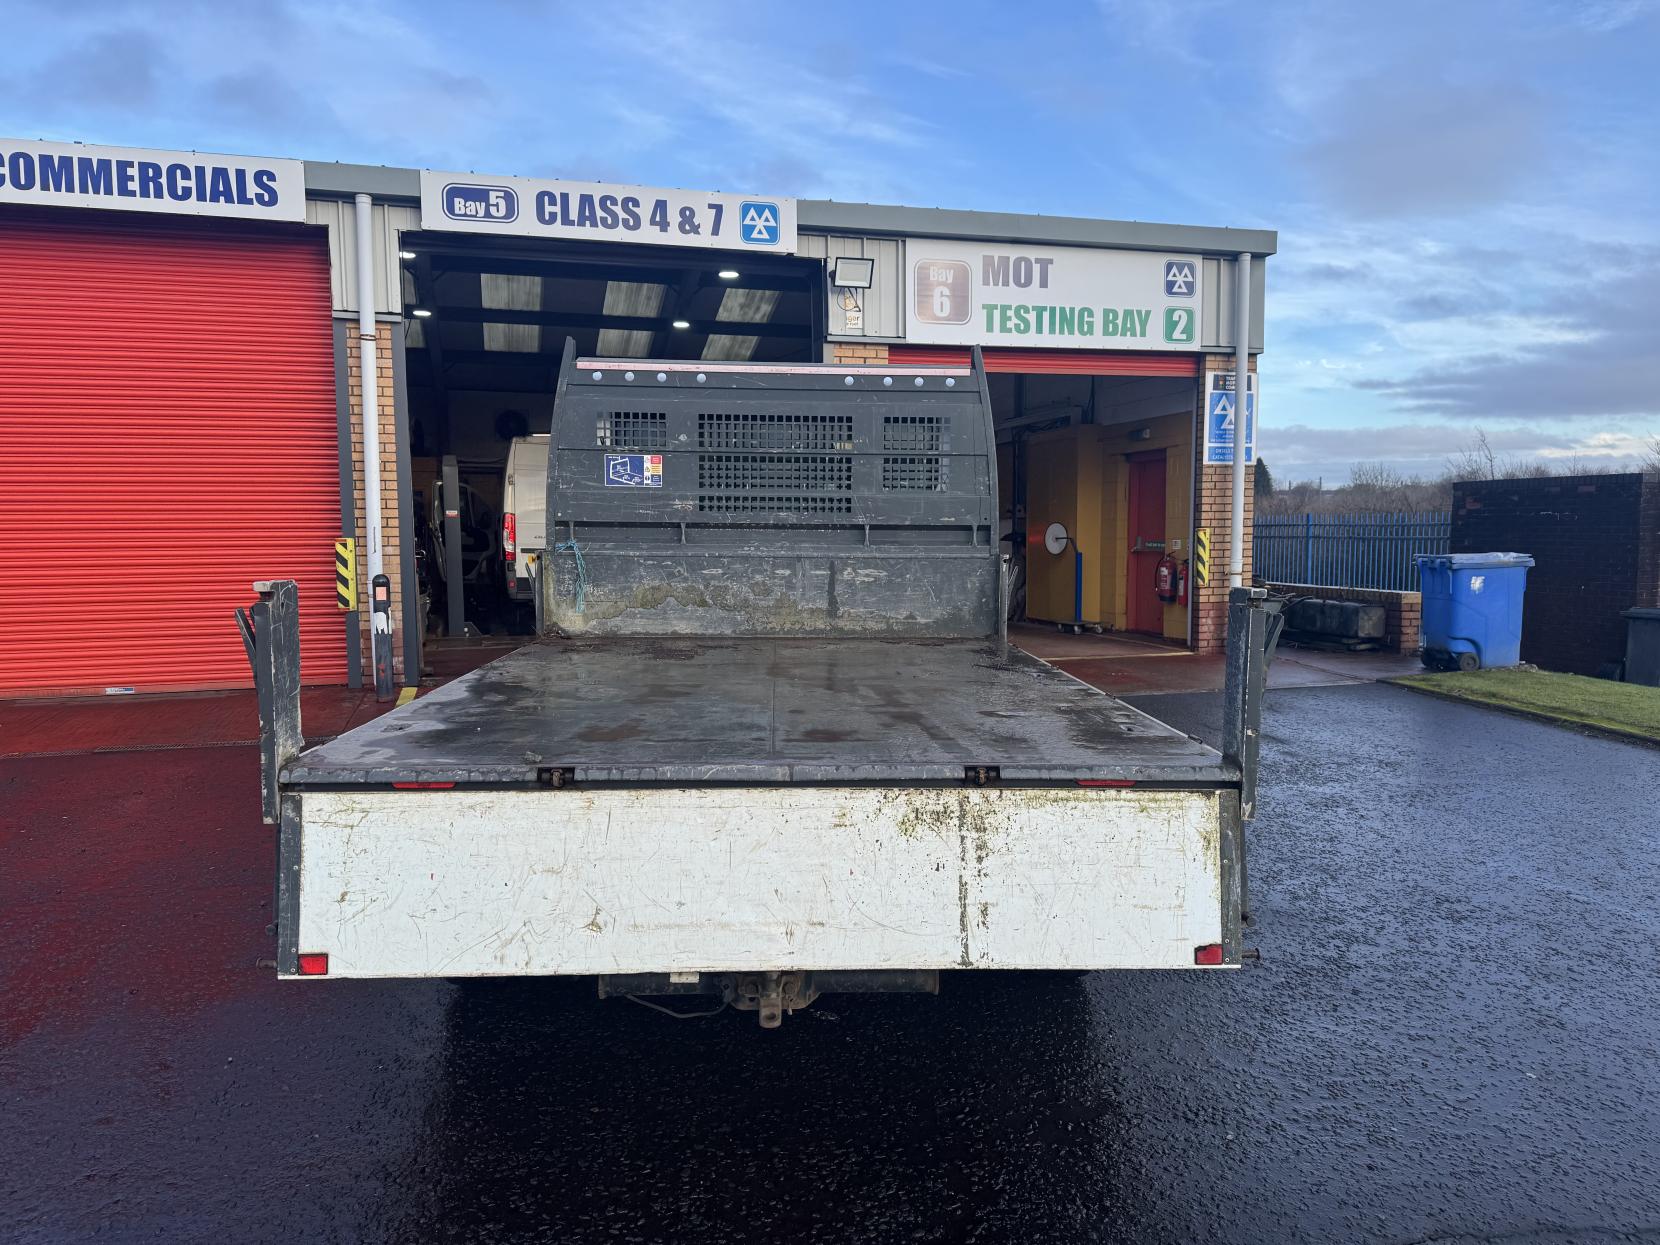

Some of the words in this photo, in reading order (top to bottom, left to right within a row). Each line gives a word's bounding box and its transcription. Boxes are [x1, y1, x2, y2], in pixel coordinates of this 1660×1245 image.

[0, 151, 279, 208] OMMERCIALS
[454, 197, 486, 217] Bay
[489, 190, 506, 217] 5
[535, 190, 642, 232] CLASS
[649, 199, 670, 233] 4
[678, 206, 701, 236] &
[707, 203, 724, 237] 7
[929, 264, 954, 284] Bay
[981, 254, 1054, 289] MOT
[932, 285, 951, 318] 6
[981, 303, 1095, 337] TESTING
[1102, 308, 1152, 338] BAY
[1171, 309, 1188, 341] 2
